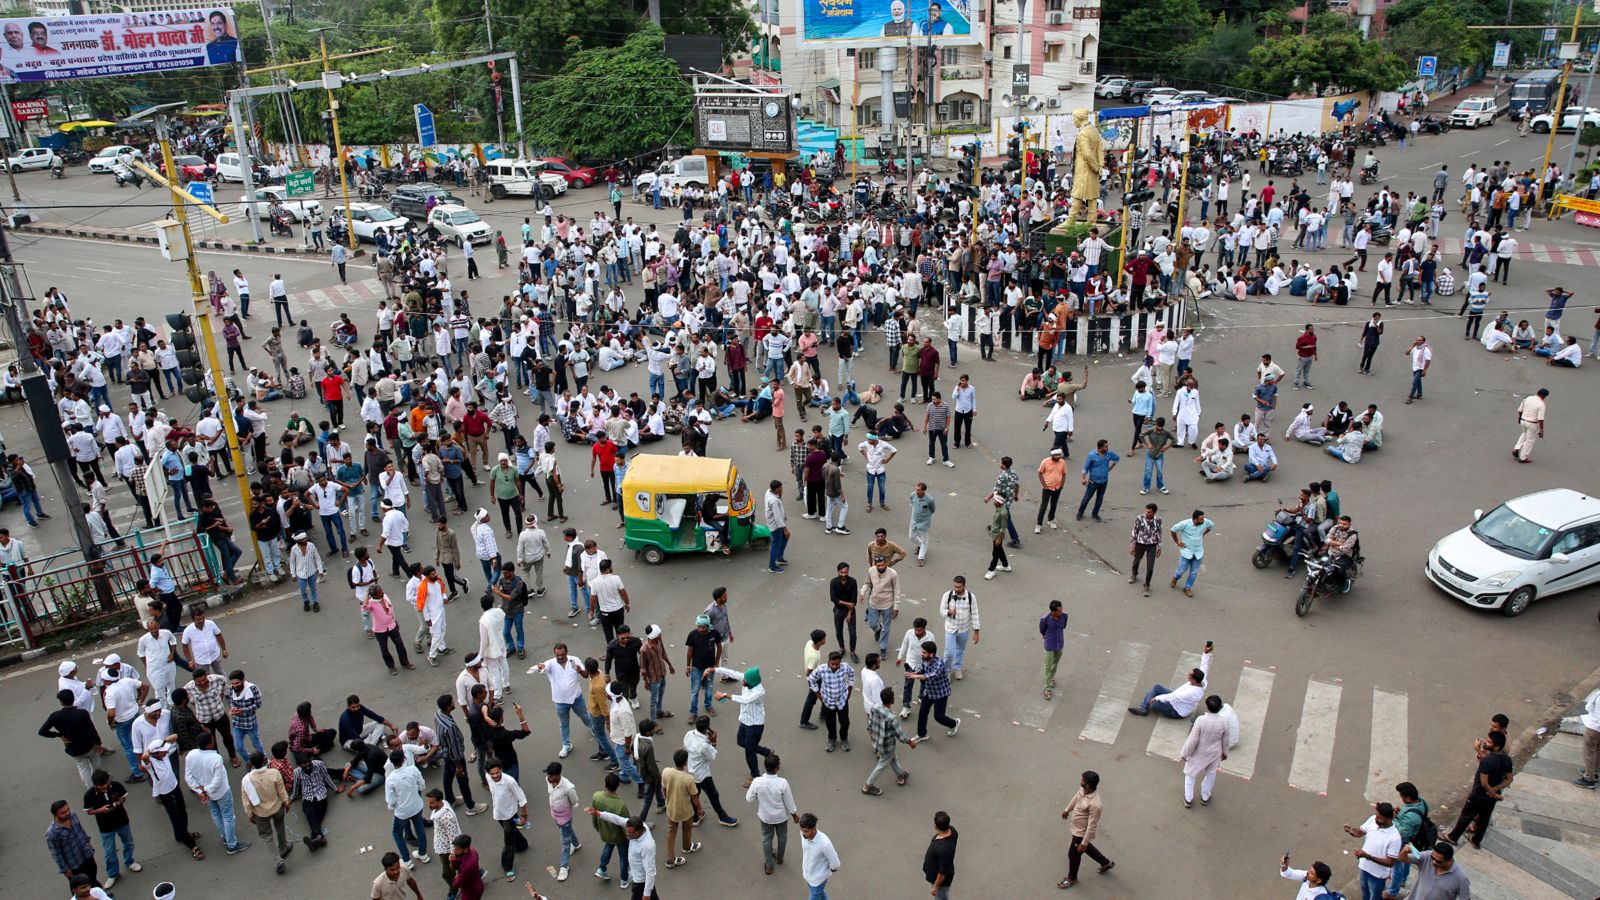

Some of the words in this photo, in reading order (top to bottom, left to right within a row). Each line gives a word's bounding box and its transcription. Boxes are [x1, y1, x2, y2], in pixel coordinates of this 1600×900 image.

[60, 39, 99, 51] जननायक
[99, 30, 121, 52] डॉ.
[122, 28, 156, 50] मोहन
[156, 30, 188, 47] यादव
[188, 25, 205, 44] जी
[25, 60, 42, 69] बहुत
[50, 58, 66, 67] बहुत
[67, 56, 96, 64] धन्यवाद
[97, 54, 114, 63] प्रदेश
[44, 70, 71, 79] निवेदक
